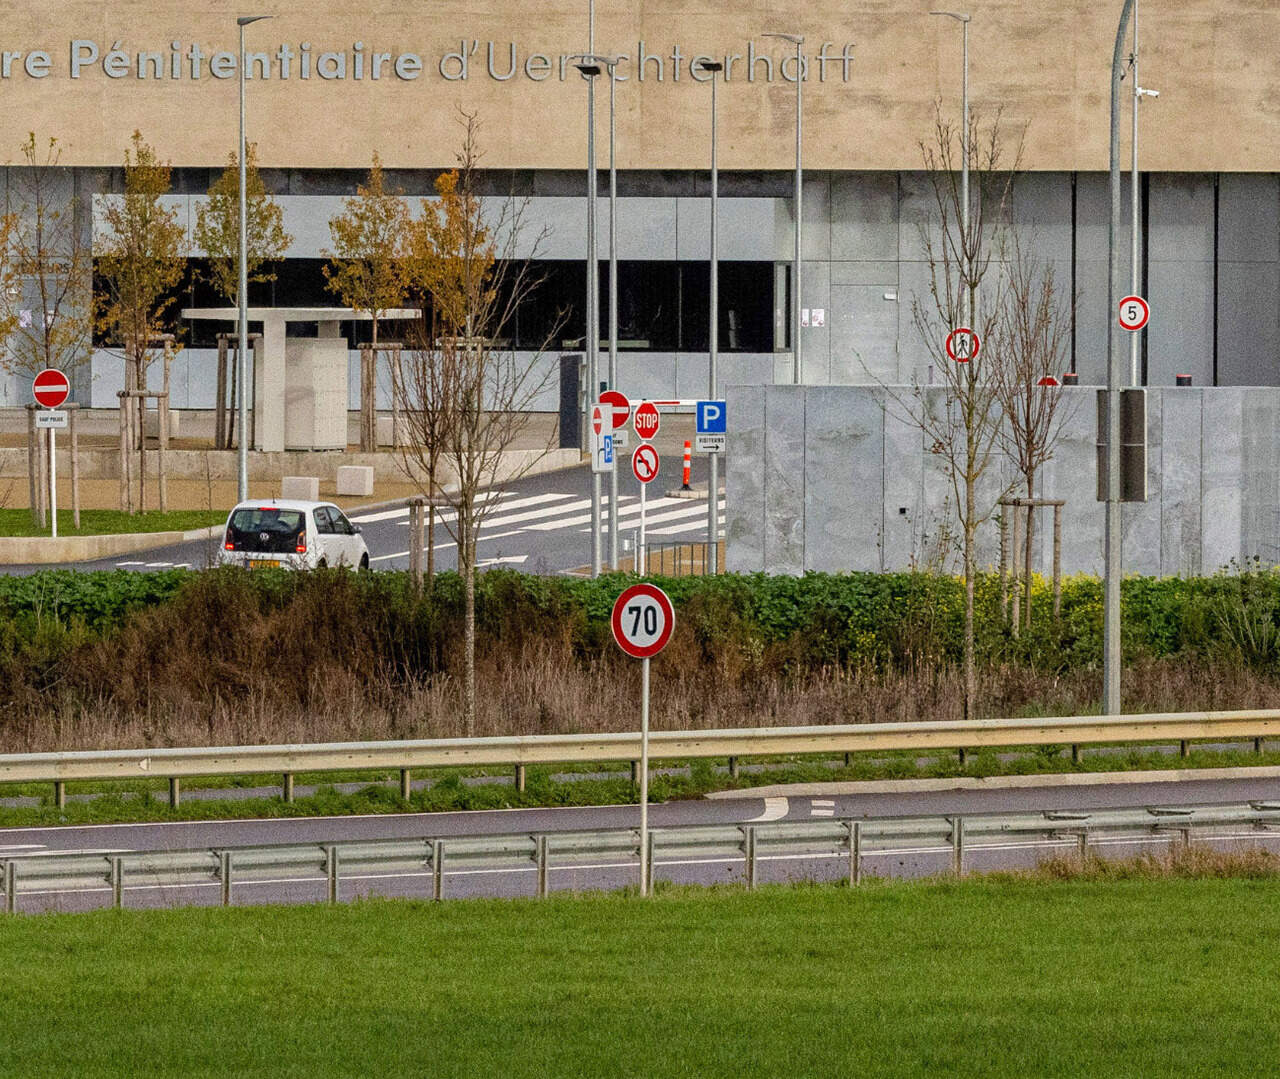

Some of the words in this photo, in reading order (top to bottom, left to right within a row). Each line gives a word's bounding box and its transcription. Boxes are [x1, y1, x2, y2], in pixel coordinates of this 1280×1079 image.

[70, 39, 423, 80] Pénitentiaire
[1128, 306, 1137, 321] 5
[636, 413, 658, 428] STOP
[703, 405, 720, 430] P
[628, 605, 657, 637] 70
